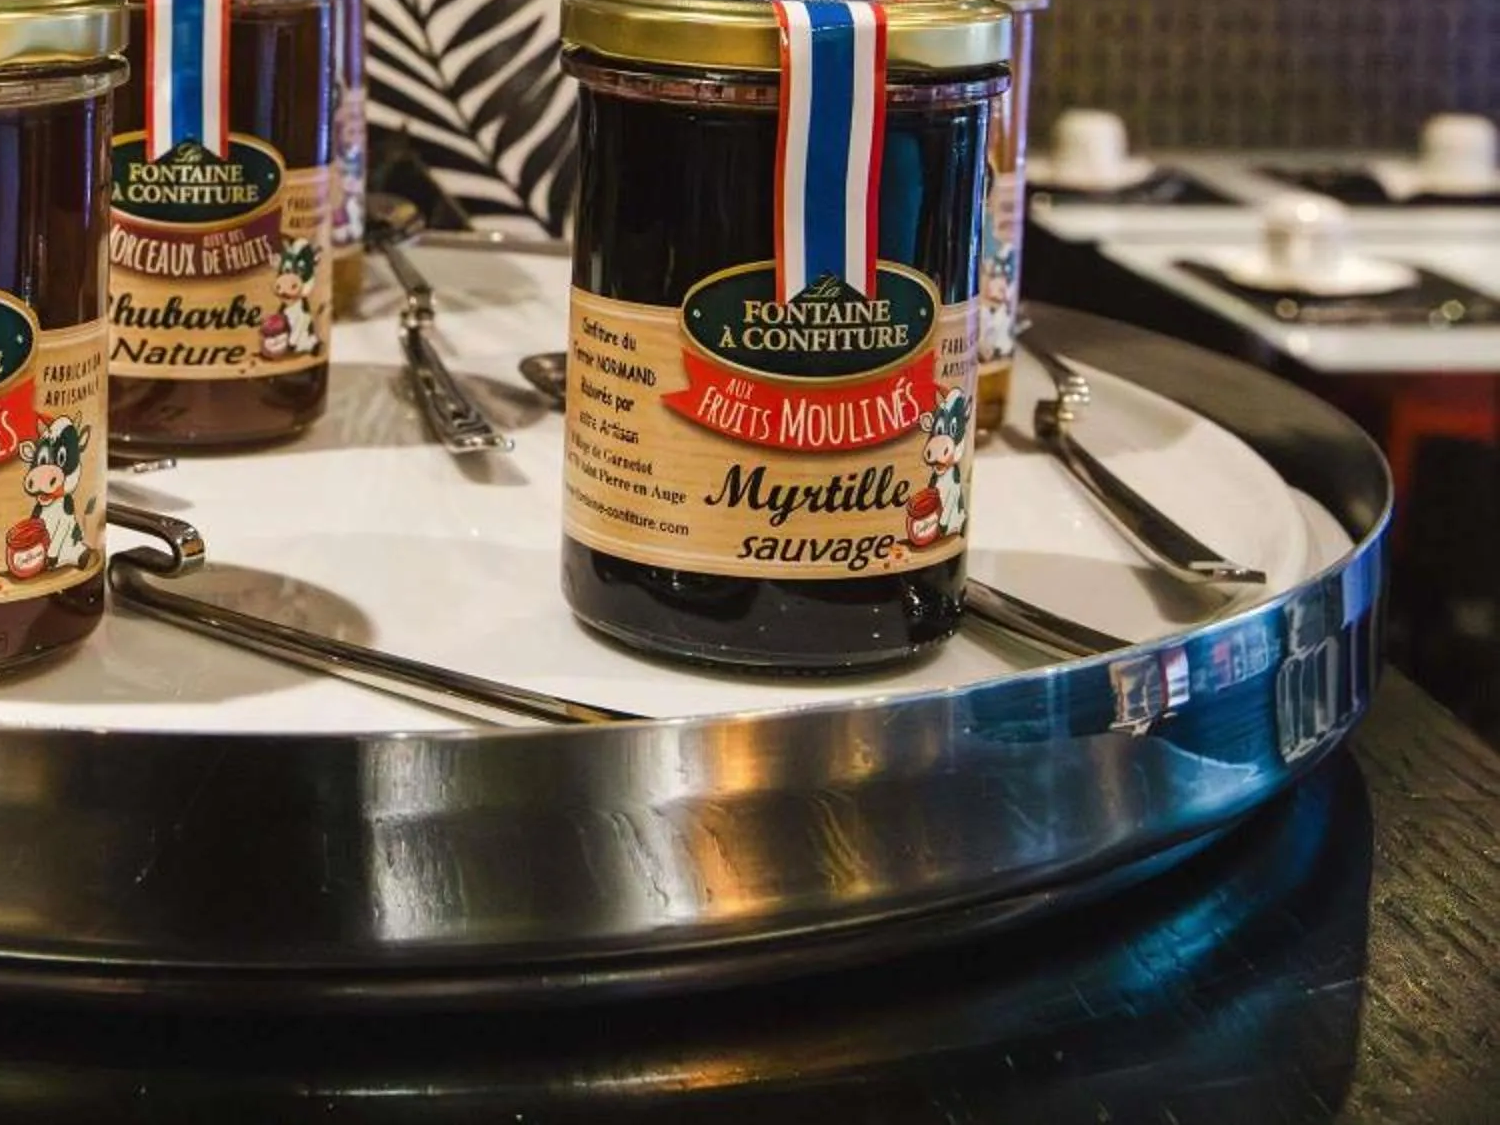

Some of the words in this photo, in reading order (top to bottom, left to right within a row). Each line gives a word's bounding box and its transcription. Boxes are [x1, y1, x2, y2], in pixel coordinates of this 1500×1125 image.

[128, 162, 245, 184] FONTAINE
[127, 183, 260, 205] CONFITURE
[202, 249, 222, 275] DE
[223, 233, 274, 272] FRUITS
[803, 274, 842, 299] La
[110, 292, 262, 331] hubarbe
[742, 299, 892, 325] FONTAINE
[111, 337, 248, 367] Nature
[718, 325, 738, 349] À
[742, 323, 910, 353] CONFITURE
[596, 354, 658, 387] NORMAND
[615, 395, 636, 413] par
[726, 377, 754, 401] AUX
[697, 386, 773, 442] FRUITS
[780, 375, 921, 447] MOULINÉS
[650, 482, 688, 506] Auge
[703, 463, 911, 528] Myrtille
[737, 532, 895, 572] sauvage
